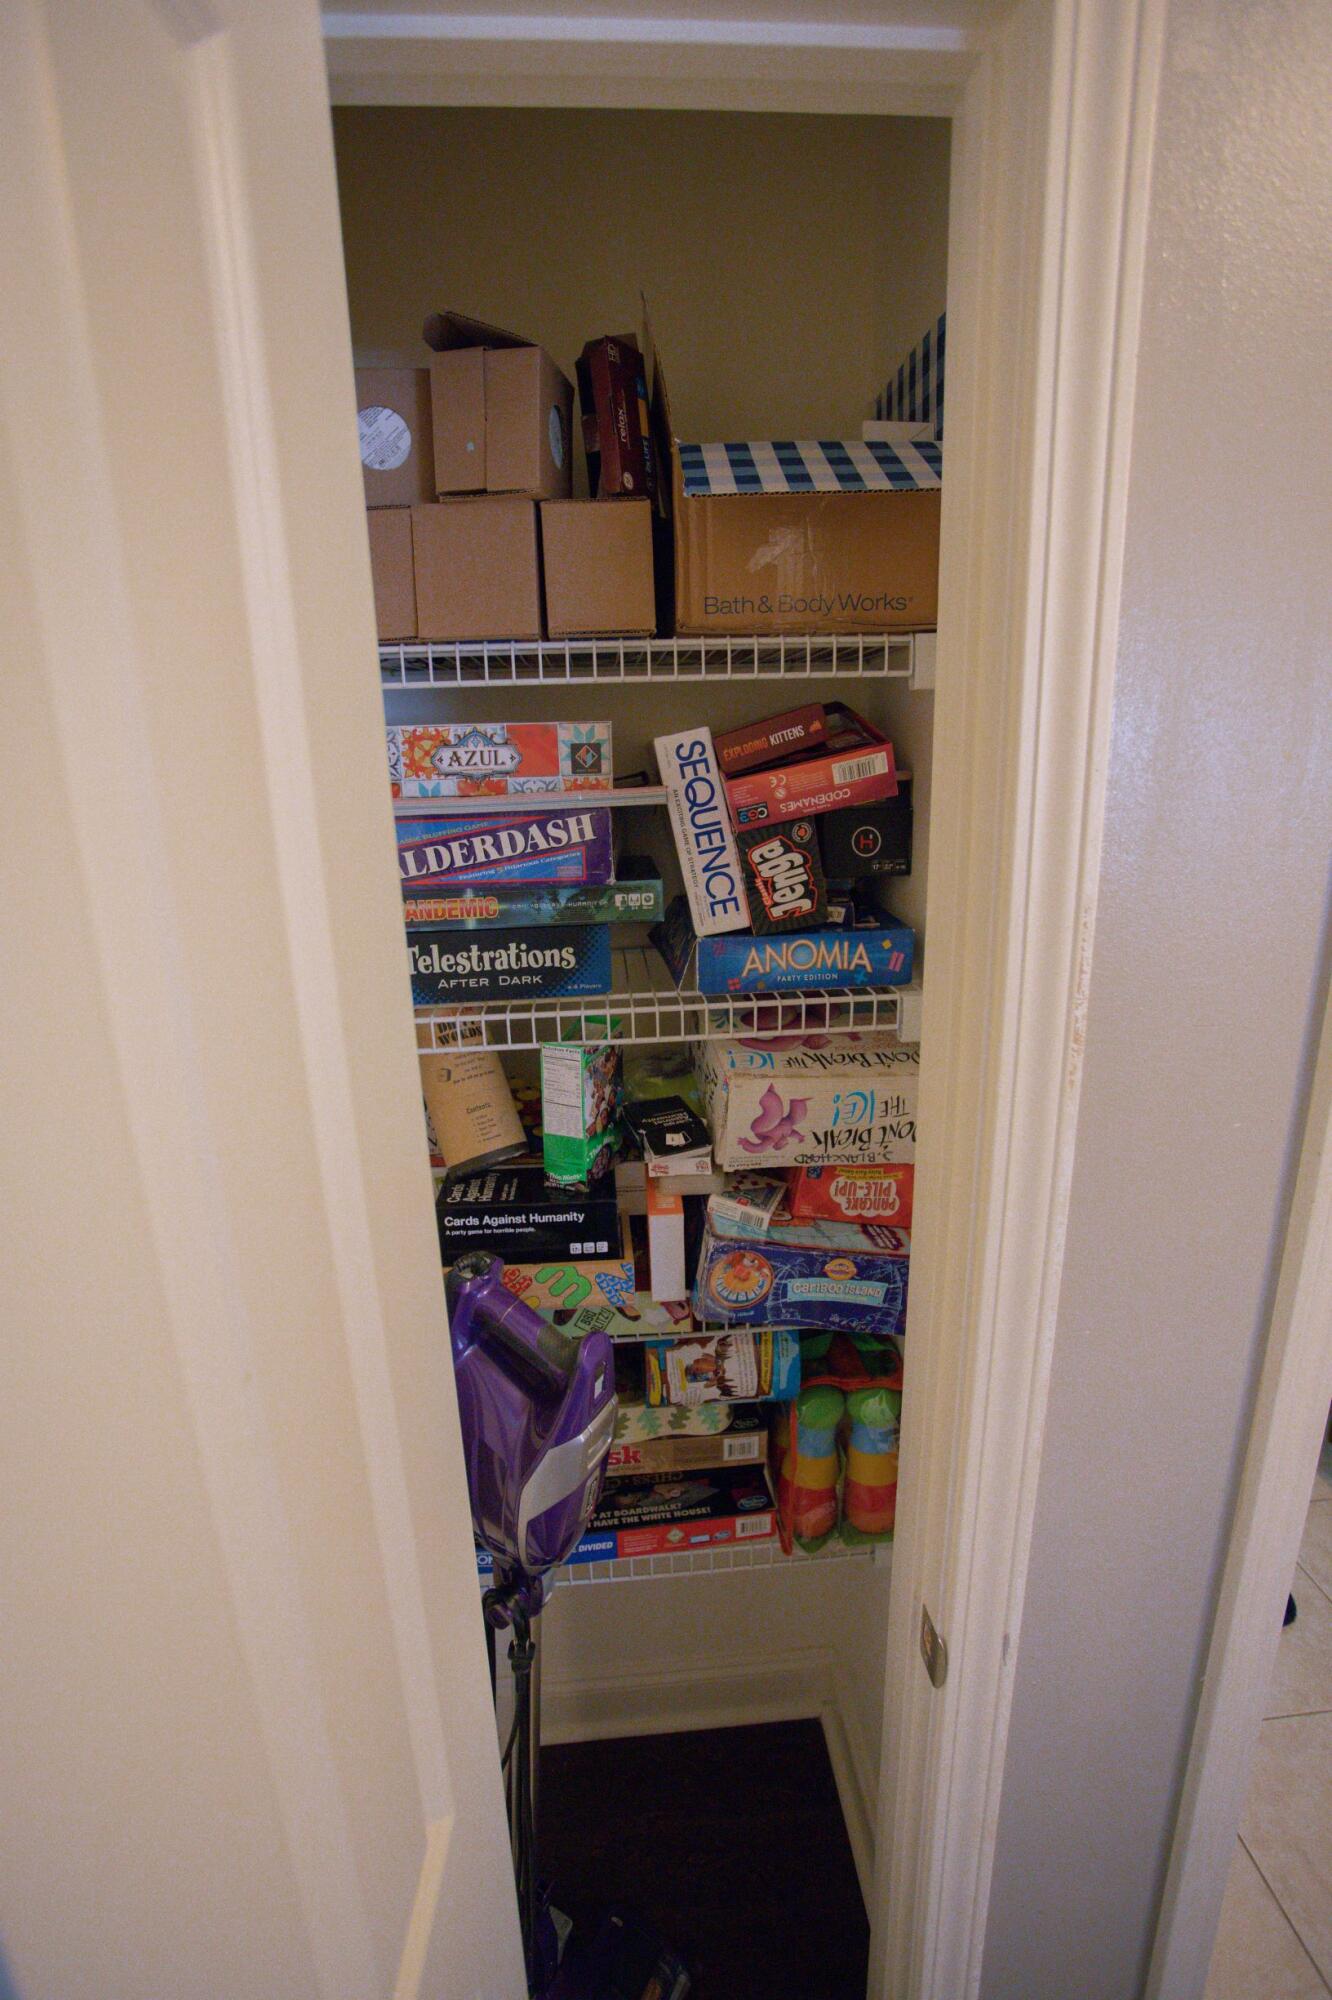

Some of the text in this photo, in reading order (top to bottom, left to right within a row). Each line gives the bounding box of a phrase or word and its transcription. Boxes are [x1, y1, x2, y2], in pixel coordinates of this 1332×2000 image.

[704, 596, 755, 615] Bath
[757, 597, 774, 612] &
[778, 594, 833, 617] Body
[722, 724, 806, 761] EXPLODING KITTENS
[446, 748, 507, 769] AZUL
[779, 788, 852, 814] CODENAMES
[674, 739, 741, 918] SEQUENCE
[750, 838, 812, 917] Jenga
[410, 943, 577, 976] Telestrations
[742, 939, 874, 977] ANOMIA
[438, 974, 543, 990] AFTER DARK
[777, 972, 839, 984] PARTY EDITION
[832, 1089, 910, 1127] THE ICE!
[794, 1149, 877, 1164] BLANCHARD
[833, 1181, 893, 1199] PILE-UP!
[444, 1211, 585, 1230] Cards Against Humanity
[594, 1518, 618, 1529] HAVE
[621, 1516, 640, 1526] THE
[640, 1511, 673, 1522] WHITE
[673, 1506, 712, 1518] HOUSE!
[598, 1511, 613, 1520] AT
[613, 1503, 683, 1517] BOARDWALK?
[578, 1541, 614, 1554] DIVIDED
